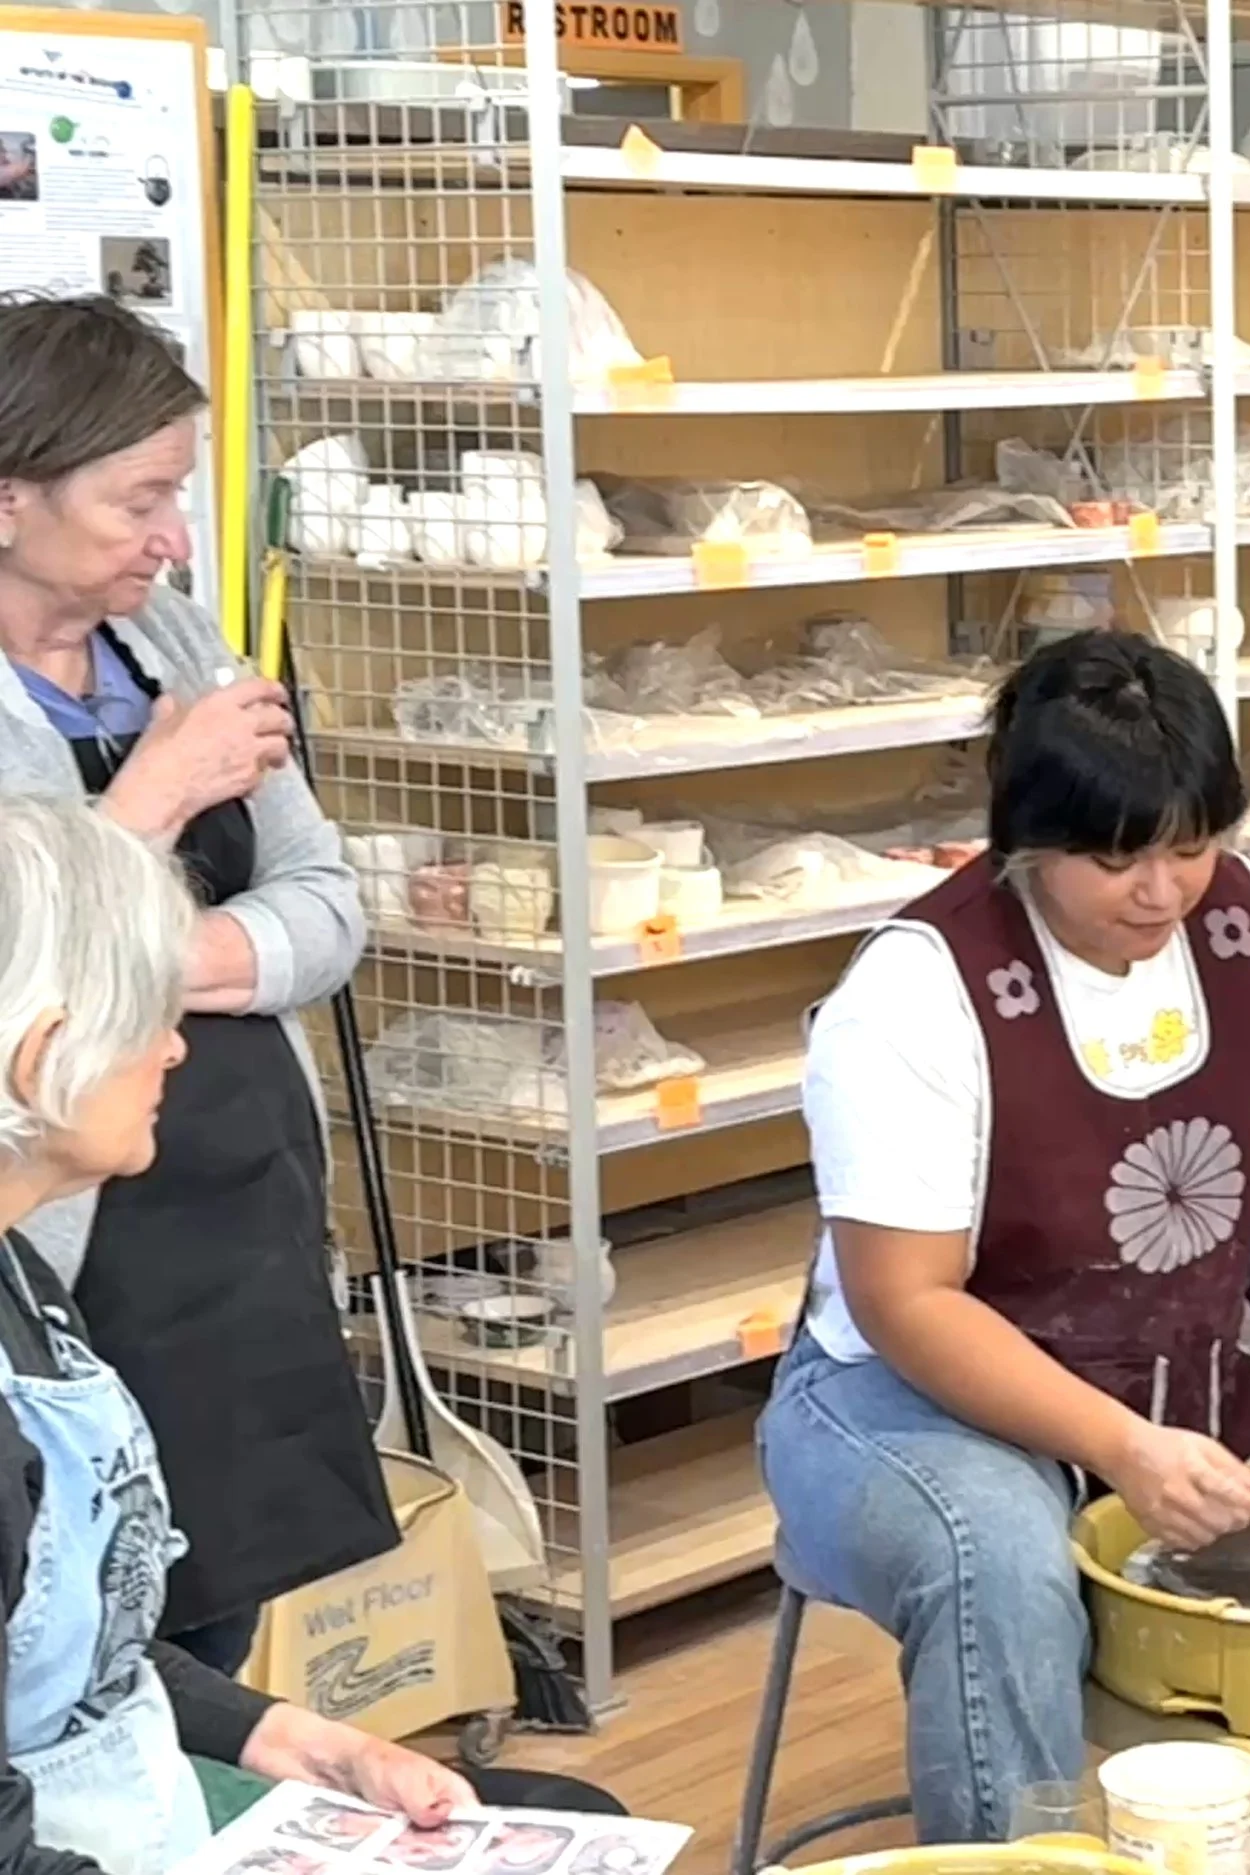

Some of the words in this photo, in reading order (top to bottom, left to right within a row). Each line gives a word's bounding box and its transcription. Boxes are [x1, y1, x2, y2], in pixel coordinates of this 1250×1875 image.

[507, 1, 678, 43] RSTROOM
[303, 1597, 356, 1638] Wet
[363, 1573, 434, 1621] Floor
